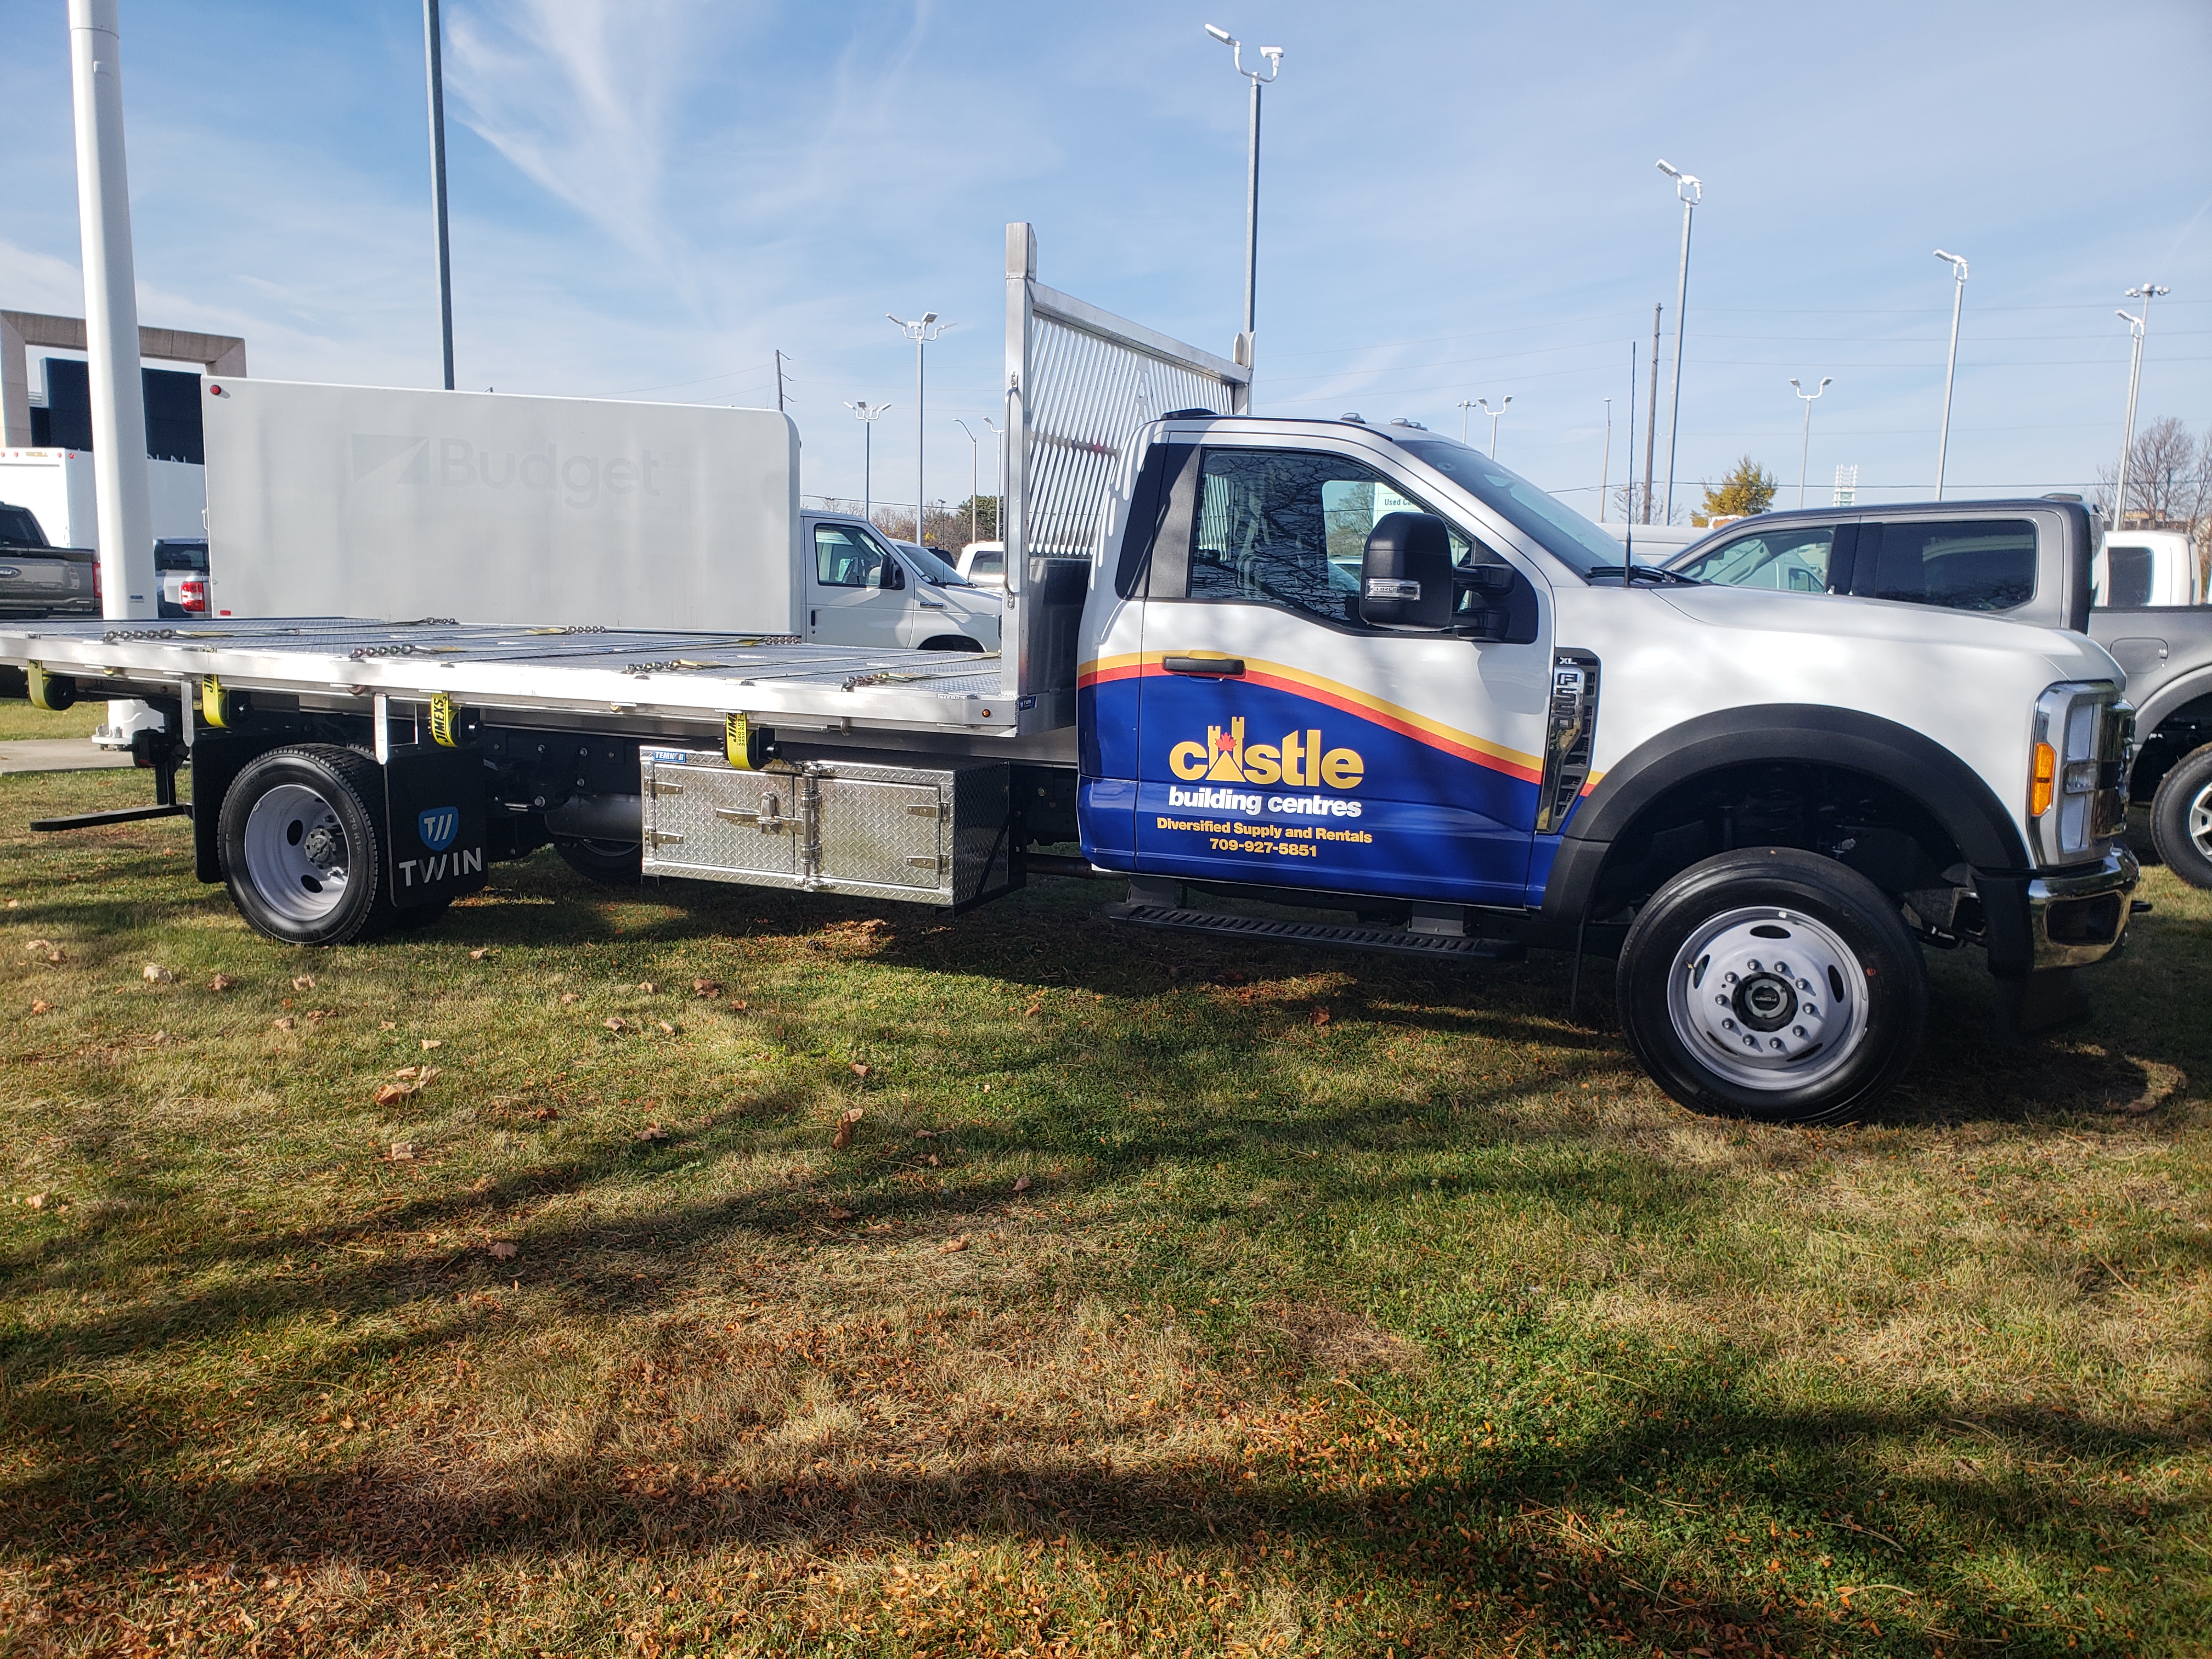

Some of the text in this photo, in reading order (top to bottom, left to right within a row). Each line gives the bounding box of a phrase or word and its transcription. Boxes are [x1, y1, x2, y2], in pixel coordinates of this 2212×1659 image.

[440, 438, 659, 510] Budget
[433, 697, 449, 743] JIMEXS
[1169, 716, 1364, 789] castle
[1169, 786, 1362, 817] building centres
[1157, 817, 1373, 843] Diversified Supply and Rentals
[1210, 838, 1318, 857] 709-927-5851
[399, 847, 482, 887] TWIN
